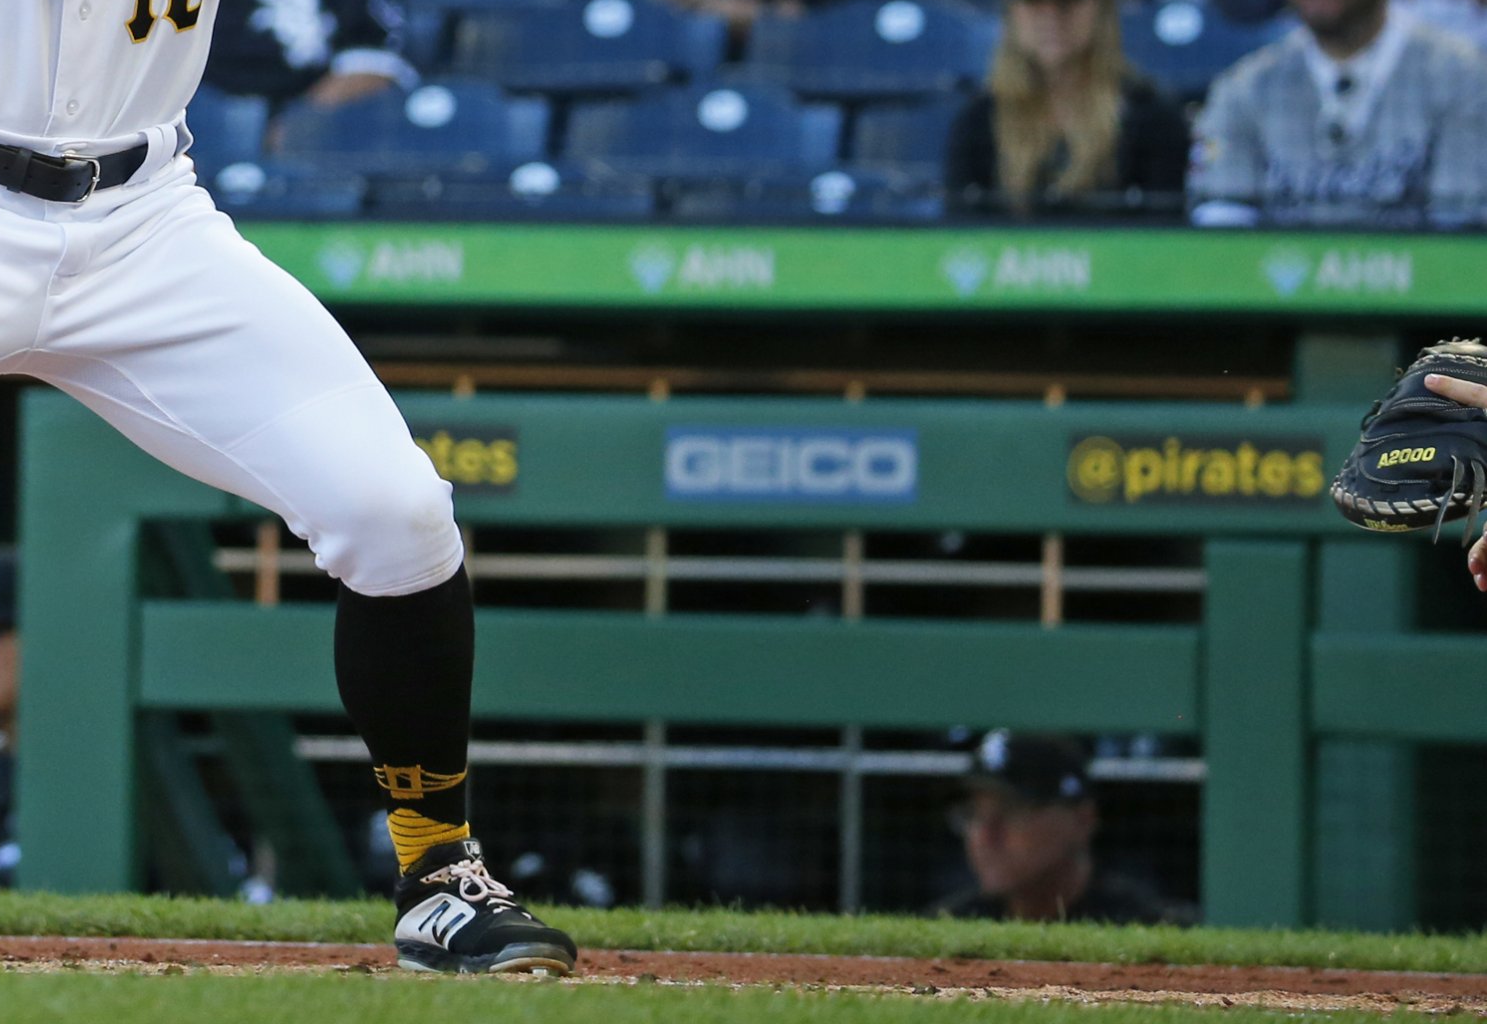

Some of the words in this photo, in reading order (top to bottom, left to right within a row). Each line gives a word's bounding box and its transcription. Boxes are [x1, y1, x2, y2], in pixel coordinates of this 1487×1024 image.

[667, 434, 917, 493] GEICO
[1067, 435, 1325, 503] @pirates
[1376, 446, 1437, 470] A2000
